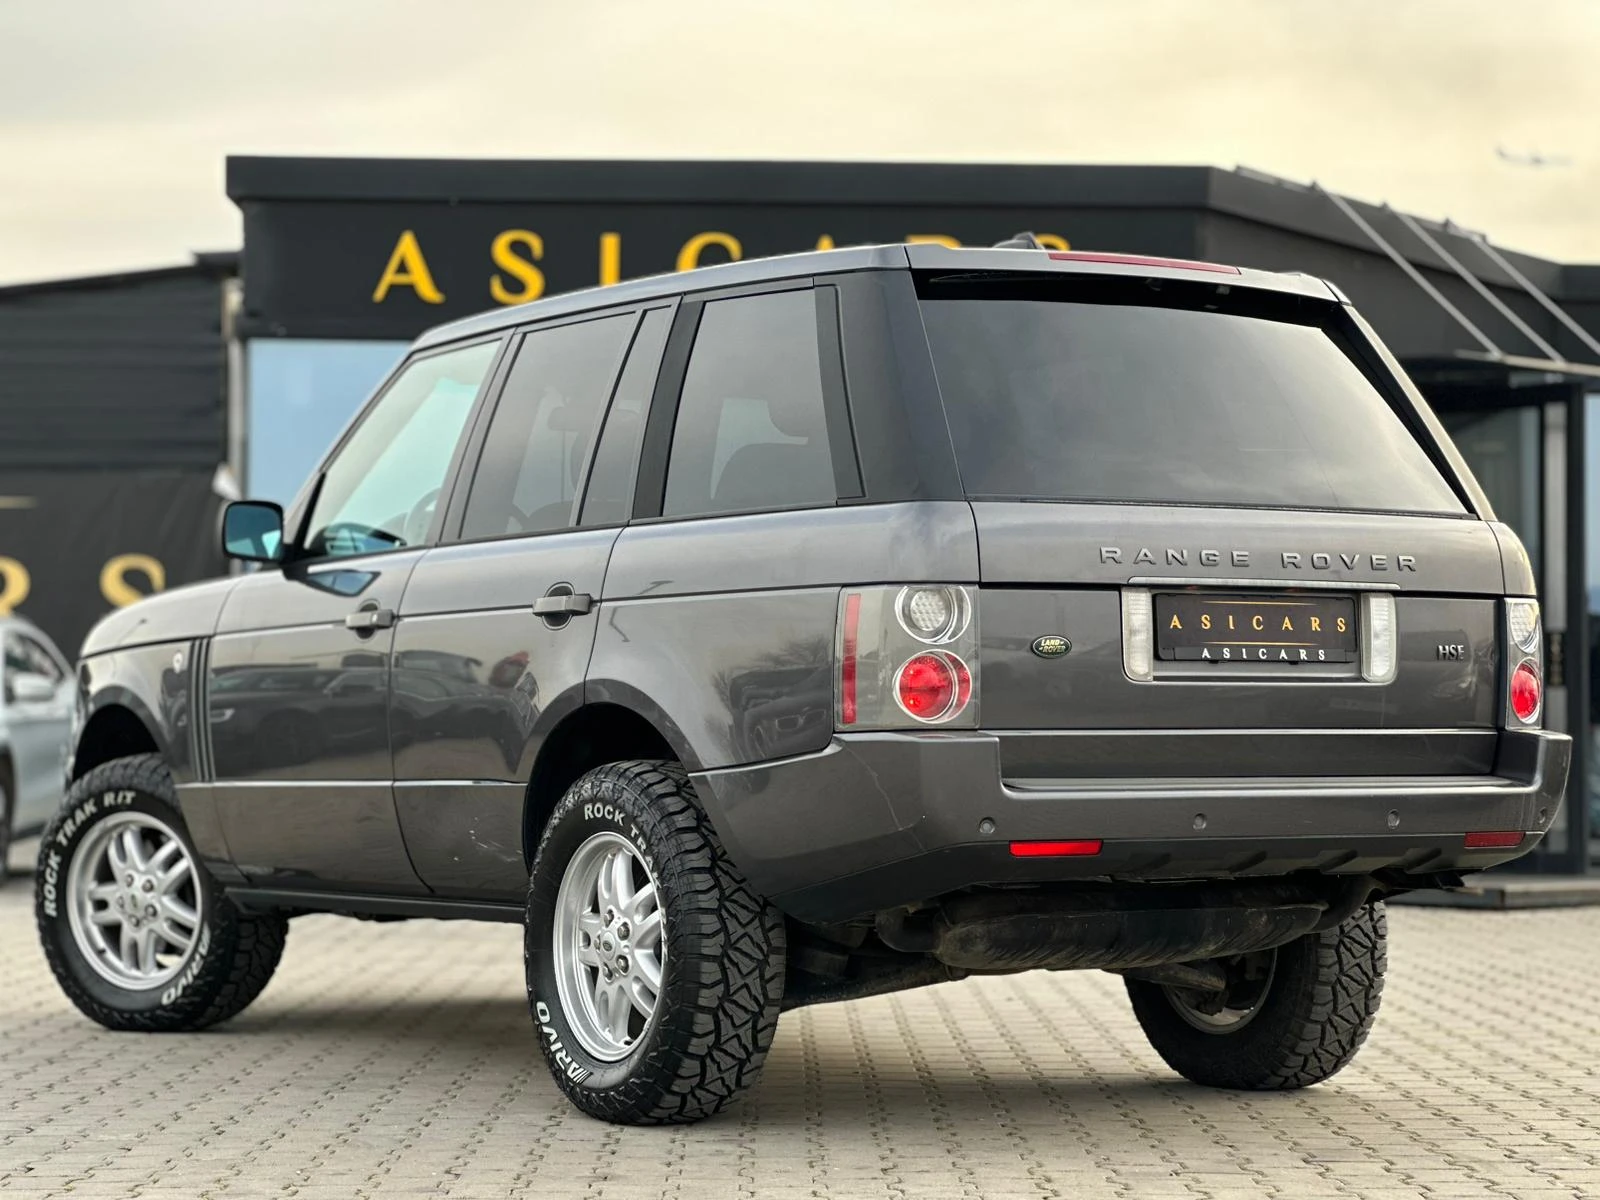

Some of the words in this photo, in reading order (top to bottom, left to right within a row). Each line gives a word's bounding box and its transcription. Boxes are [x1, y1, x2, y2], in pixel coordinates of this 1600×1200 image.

[1099, 546, 1250, 568] RANGE
[1281, 552, 1417, 572] ROVER
[1169, 613, 1347, 633] ASICARS
[1201, 647, 1325, 661] ASICARS
[1436, 644, 1465, 661] HSE
[584, 801, 626, 826] ROCK
[44, 849, 62, 917] ROCK
[56, 798, 97, 847] TRAK
[103, 790, 136, 808] R/T
[535, 1000, 595, 1084] ARIVO
